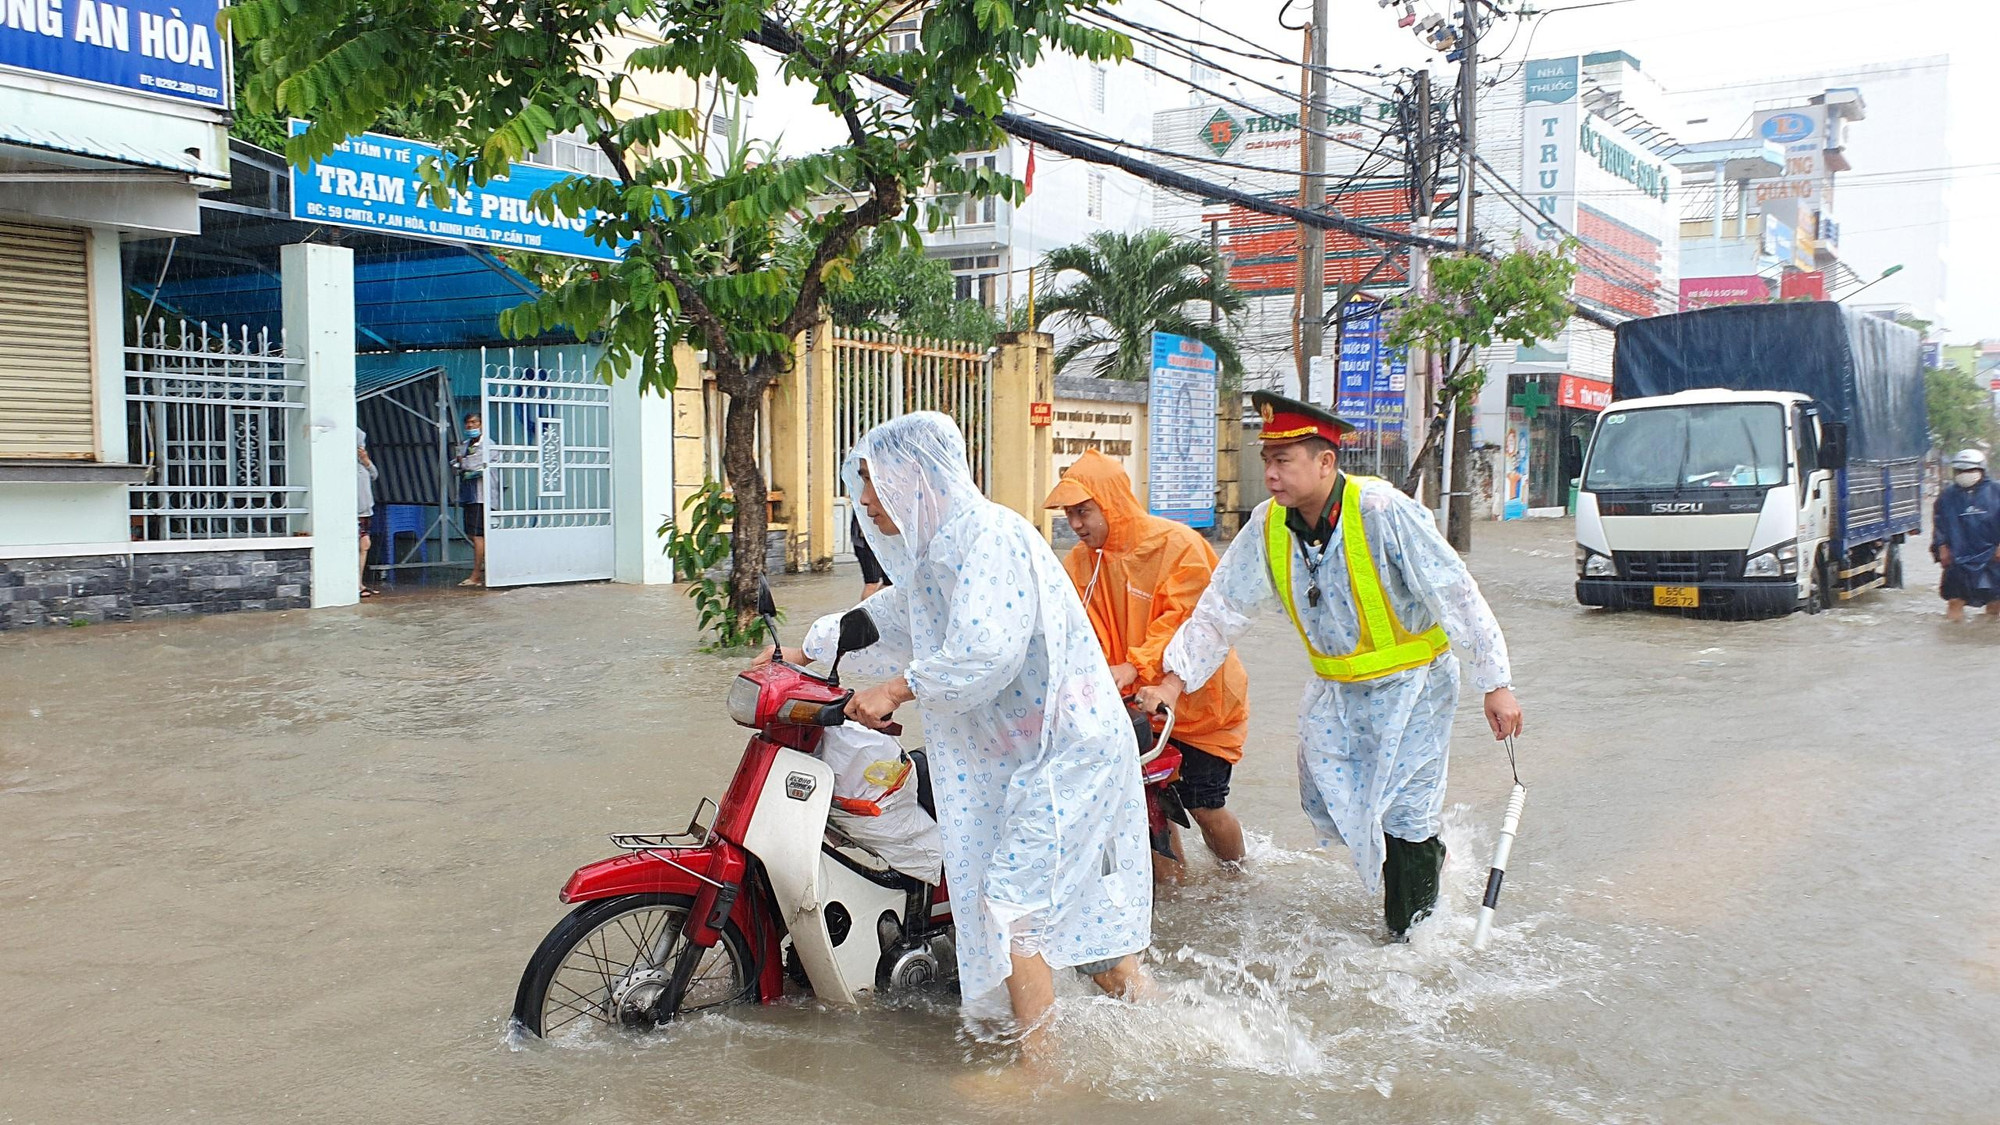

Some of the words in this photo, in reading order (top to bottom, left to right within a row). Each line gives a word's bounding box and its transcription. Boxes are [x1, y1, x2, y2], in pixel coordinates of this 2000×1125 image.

[75, 0, 130, 52] AN
[140, 7, 214, 70] HÒA
[1530, 81, 1573, 94] THUỐC
[1246, 113, 1300, 133] TRUN
[353, 141, 381, 158] TÂM
[383, 147, 395, 160] Y
[394, 148, 411, 163] TẾ
[315, 164, 405, 206] TRẠM
[307, 202, 326, 216] ĐC:
[328, 205, 342, 218] 59
[378, 213, 402, 227] P.AN
[405, 215, 427, 232] HÒA,
[1651, 502, 1703, 513] ISUZU
[1665, 587, 1686, 596] 65C
